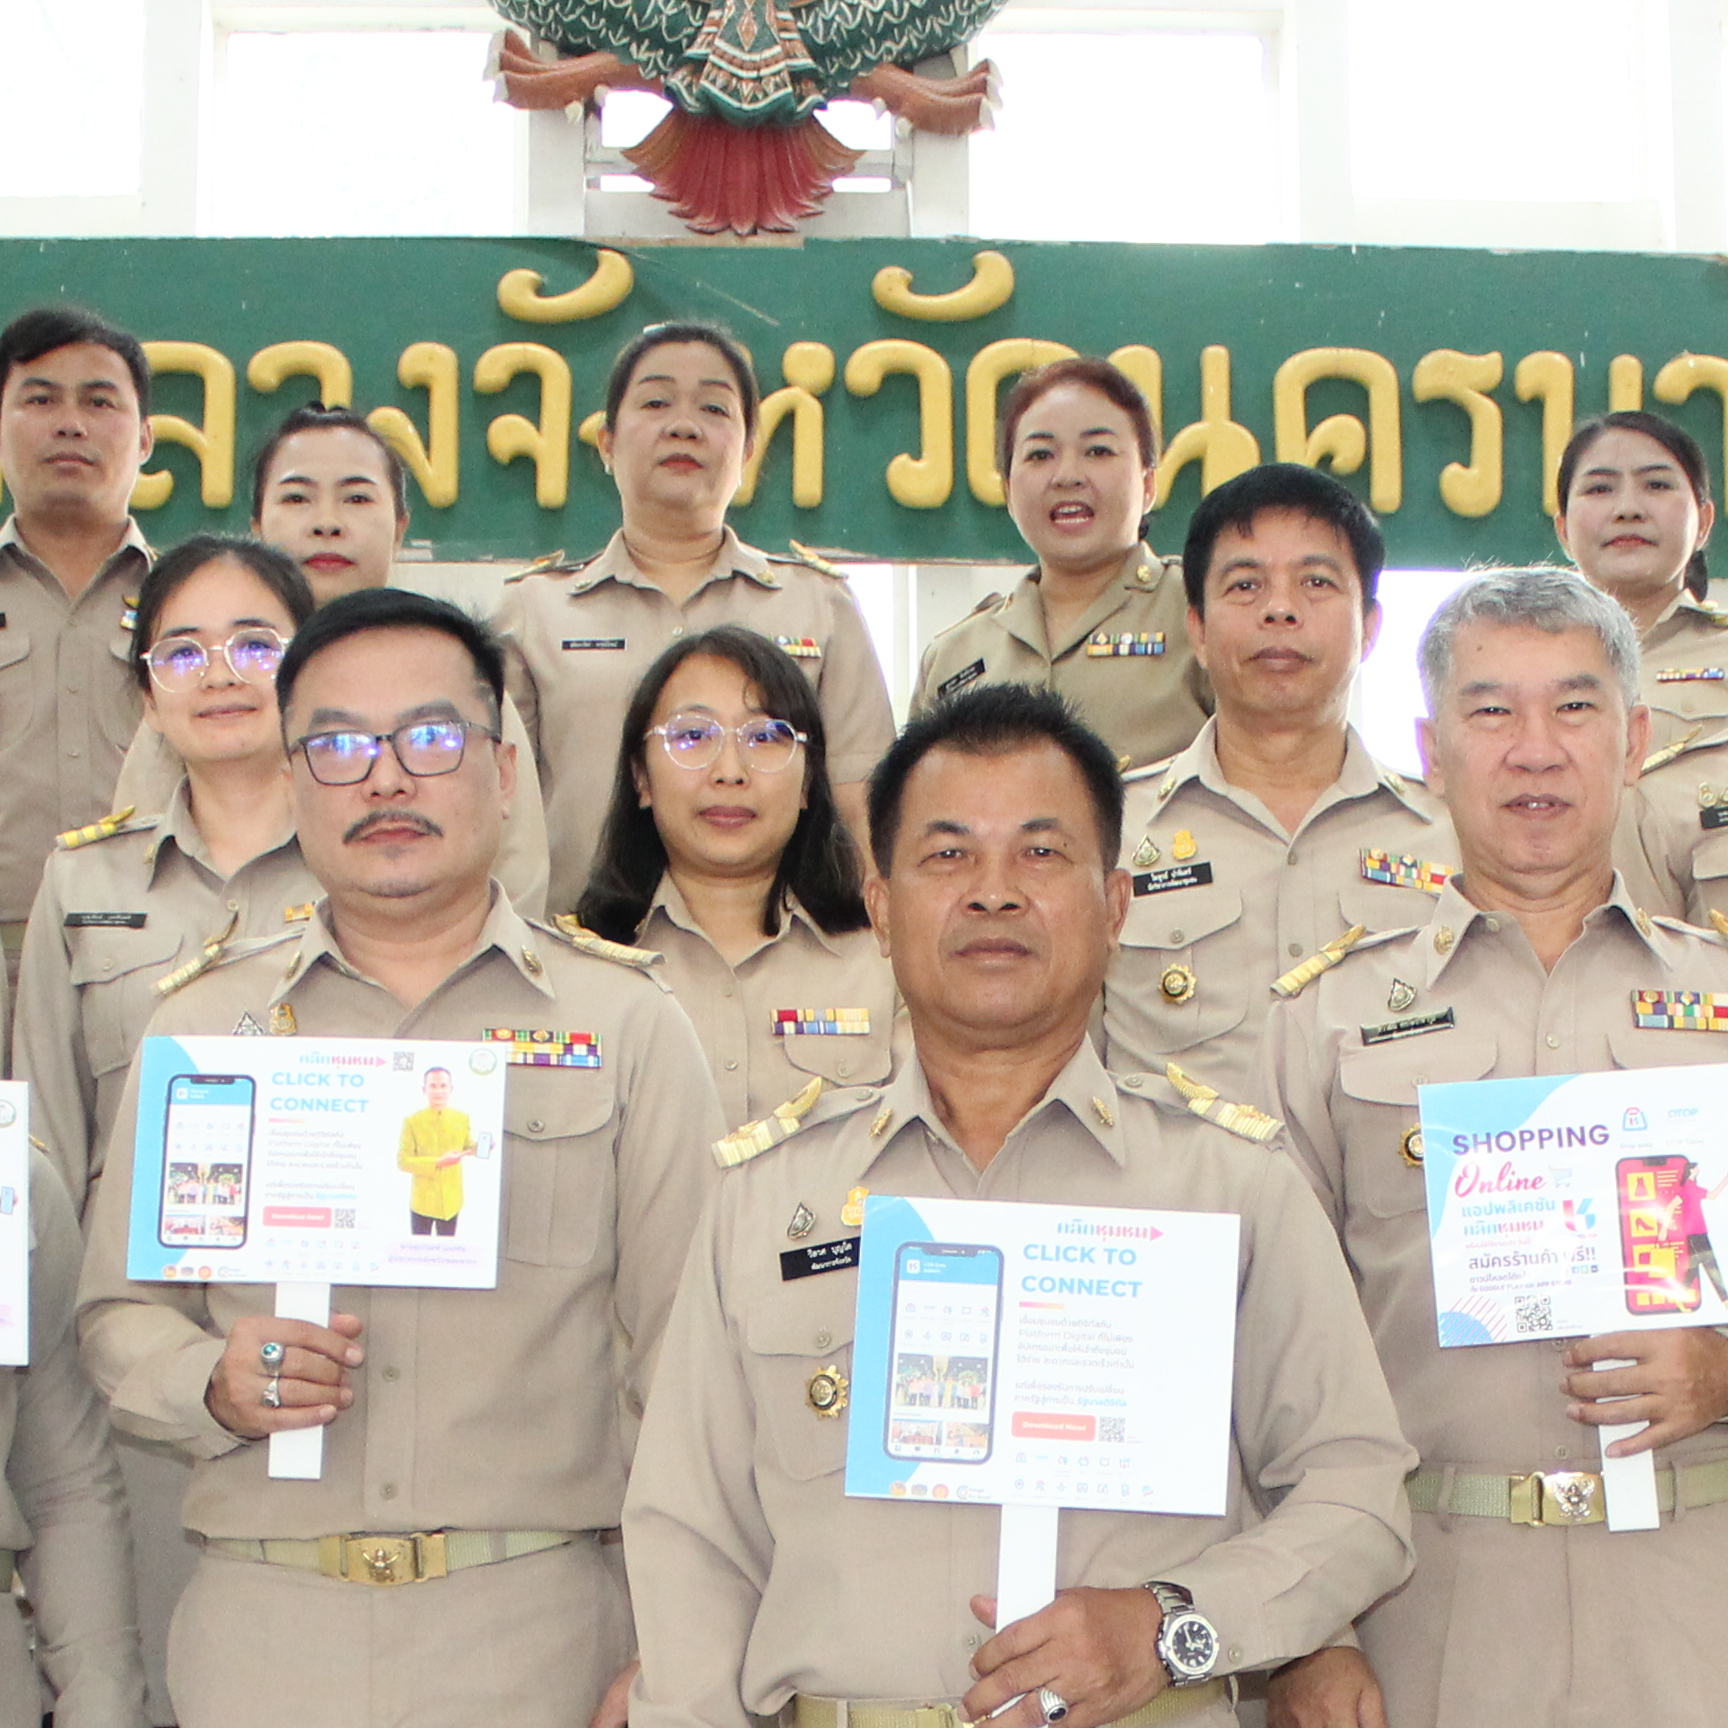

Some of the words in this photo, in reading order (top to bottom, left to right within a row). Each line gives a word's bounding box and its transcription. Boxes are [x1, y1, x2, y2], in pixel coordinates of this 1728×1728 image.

[272, 1072, 330, 1086] CLICK
[338, 1074, 365, 1087] TO
[270, 1096, 369, 1113] CONNECT
[1667, 1108, 1698, 1118] OTOP
[1452, 1124, 1610, 1156] SHOPPING
[1454, 1160, 1547, 1198] Online
[1461, 1196, 1556, 1217] แอปพลิเคชัน
[1023, 1243, 1096, 1264] CLICK
[1103, 1248, 1137, 1265] TO
[1469, 1248, 1558, 1270] สมัครร้านค้า
[1021, 1275, 1143, 1298] CONNECT
[1551, 1280, 1572, 1288] STRE
[1018, 1329, 1061, 1340] Platform
[1063, 1331, 1095, 1342] Digital
[1022, 1421, 1064, 1430] Download
[1066, 1422, 1086, 1431] Now!
